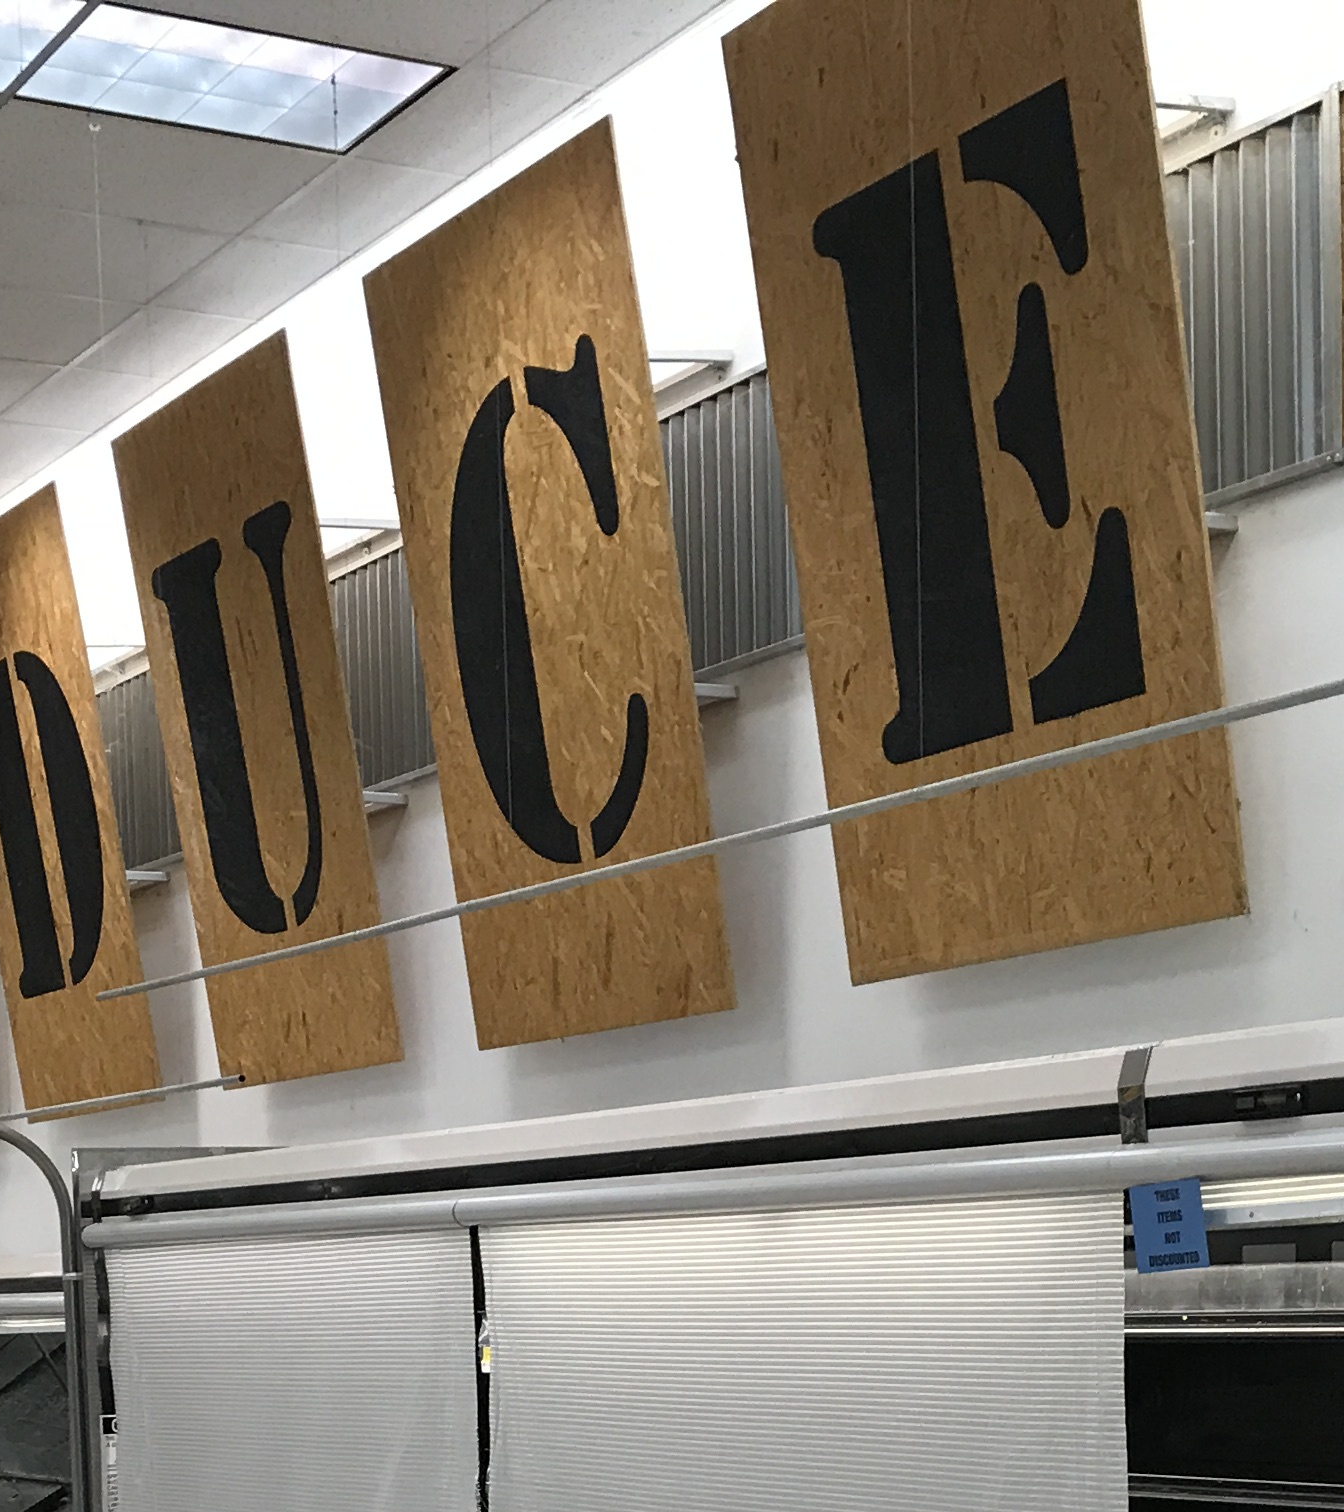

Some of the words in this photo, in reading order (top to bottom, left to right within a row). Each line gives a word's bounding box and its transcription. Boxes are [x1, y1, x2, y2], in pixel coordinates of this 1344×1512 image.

[1154, 1187, 1182, 1203] THESE
[1156, 1209, 1183, 1224] ITEMS
[1164, 1230, 1181, 1245] NOT
[1148, 1250, 1200, 1267] DISCOUNTED
